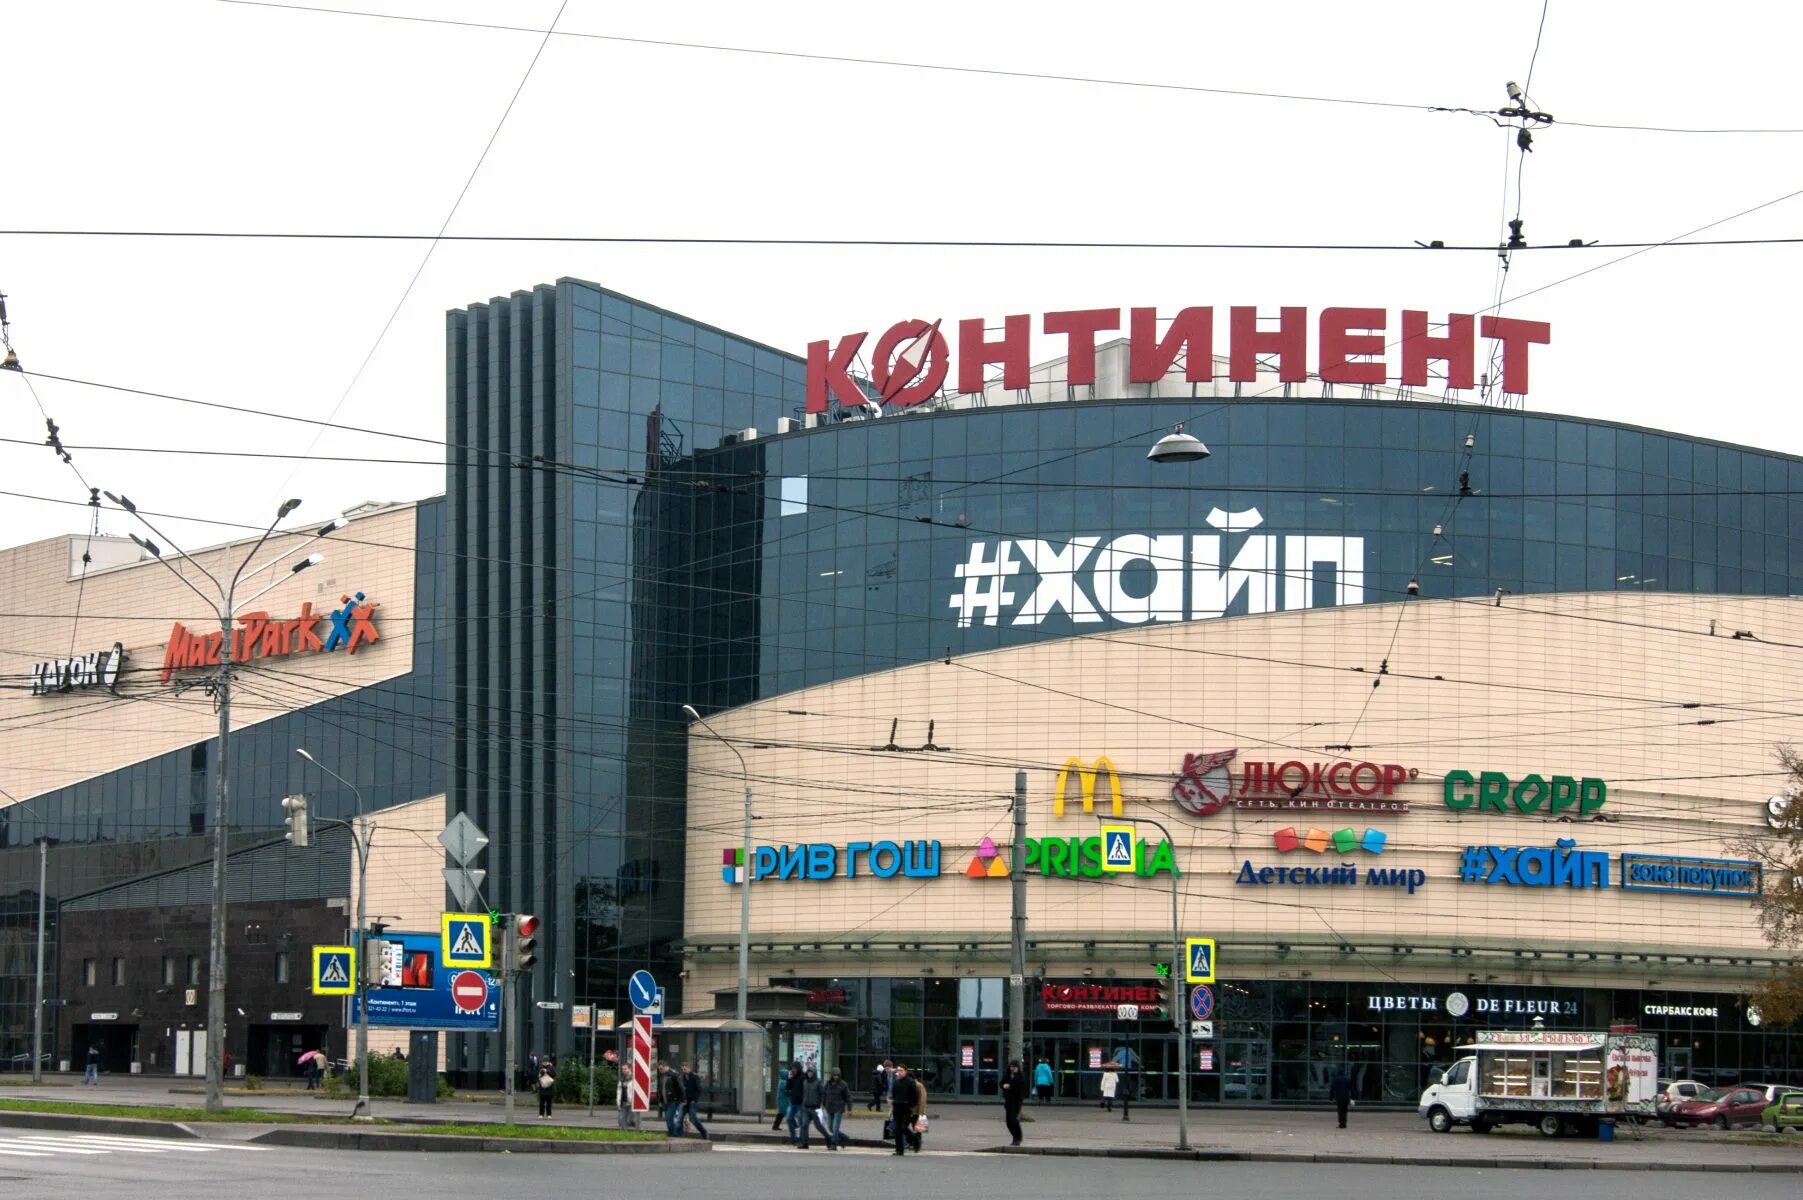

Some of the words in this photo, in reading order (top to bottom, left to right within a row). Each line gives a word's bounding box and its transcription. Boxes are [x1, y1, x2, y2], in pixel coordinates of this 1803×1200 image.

[806, 306, 1551, 414] КОНТИНЕНТ
[31, 652, 99, 696] КАТОК
[1239, 760, 1406, 798] ЛЮКСОР
[1444, 770, 1607, 815] CROPP
[755, 843, 837, 880] РИВ
[846, 839, 941, 879] ГОШ
[1235, 860, 1357, 886] Детский
[1366, 867, 1426, 894] мир
[1368, 996, 1437, 1012] ЦВЕТЫ
[1477, 998, 1500, 1012] DE
[1504, 999, 1560, 1013] FLEUR
[1563, 1001, 1578, 1014] 24
[1645, 1005, 1692, 1016] СТАРБАКС
[1693, 1007, 1719, 1017] КОФЕ
